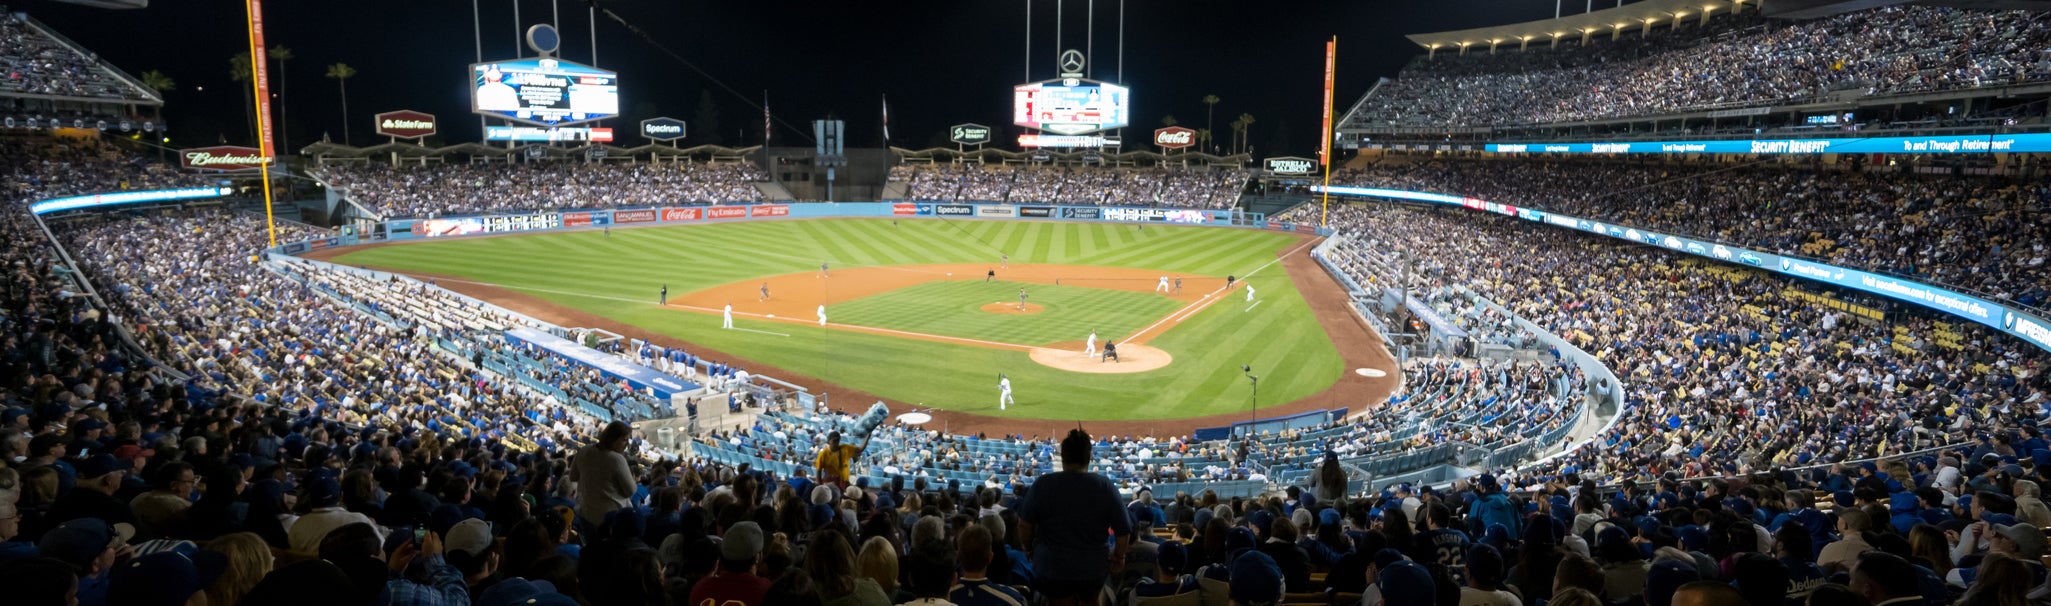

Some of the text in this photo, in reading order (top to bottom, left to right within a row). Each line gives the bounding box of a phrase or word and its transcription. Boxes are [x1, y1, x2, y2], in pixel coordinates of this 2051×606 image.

[646, 124, 680, 134] Spectrum
[1751, 140, 1788, 153] SECURITY
[1904, 140, 1912, 151] To
[1913, 140, 1927, 150] and
[1929, 140, 1960, 152] Through
[1270, 160, 1312, 168] ESTRELLA
[666, 209, 695, 220] Coca-Cola
[708, 209, 718, 217] Fly
[937, 206, 969, 214] Spectrum
[1862, 274, 1876, 287] Visit
[1926, 290, 1935, 302] for
[1935, 294, 1969, 312] exceptional
[1437, 546, 1461, 566] 22
